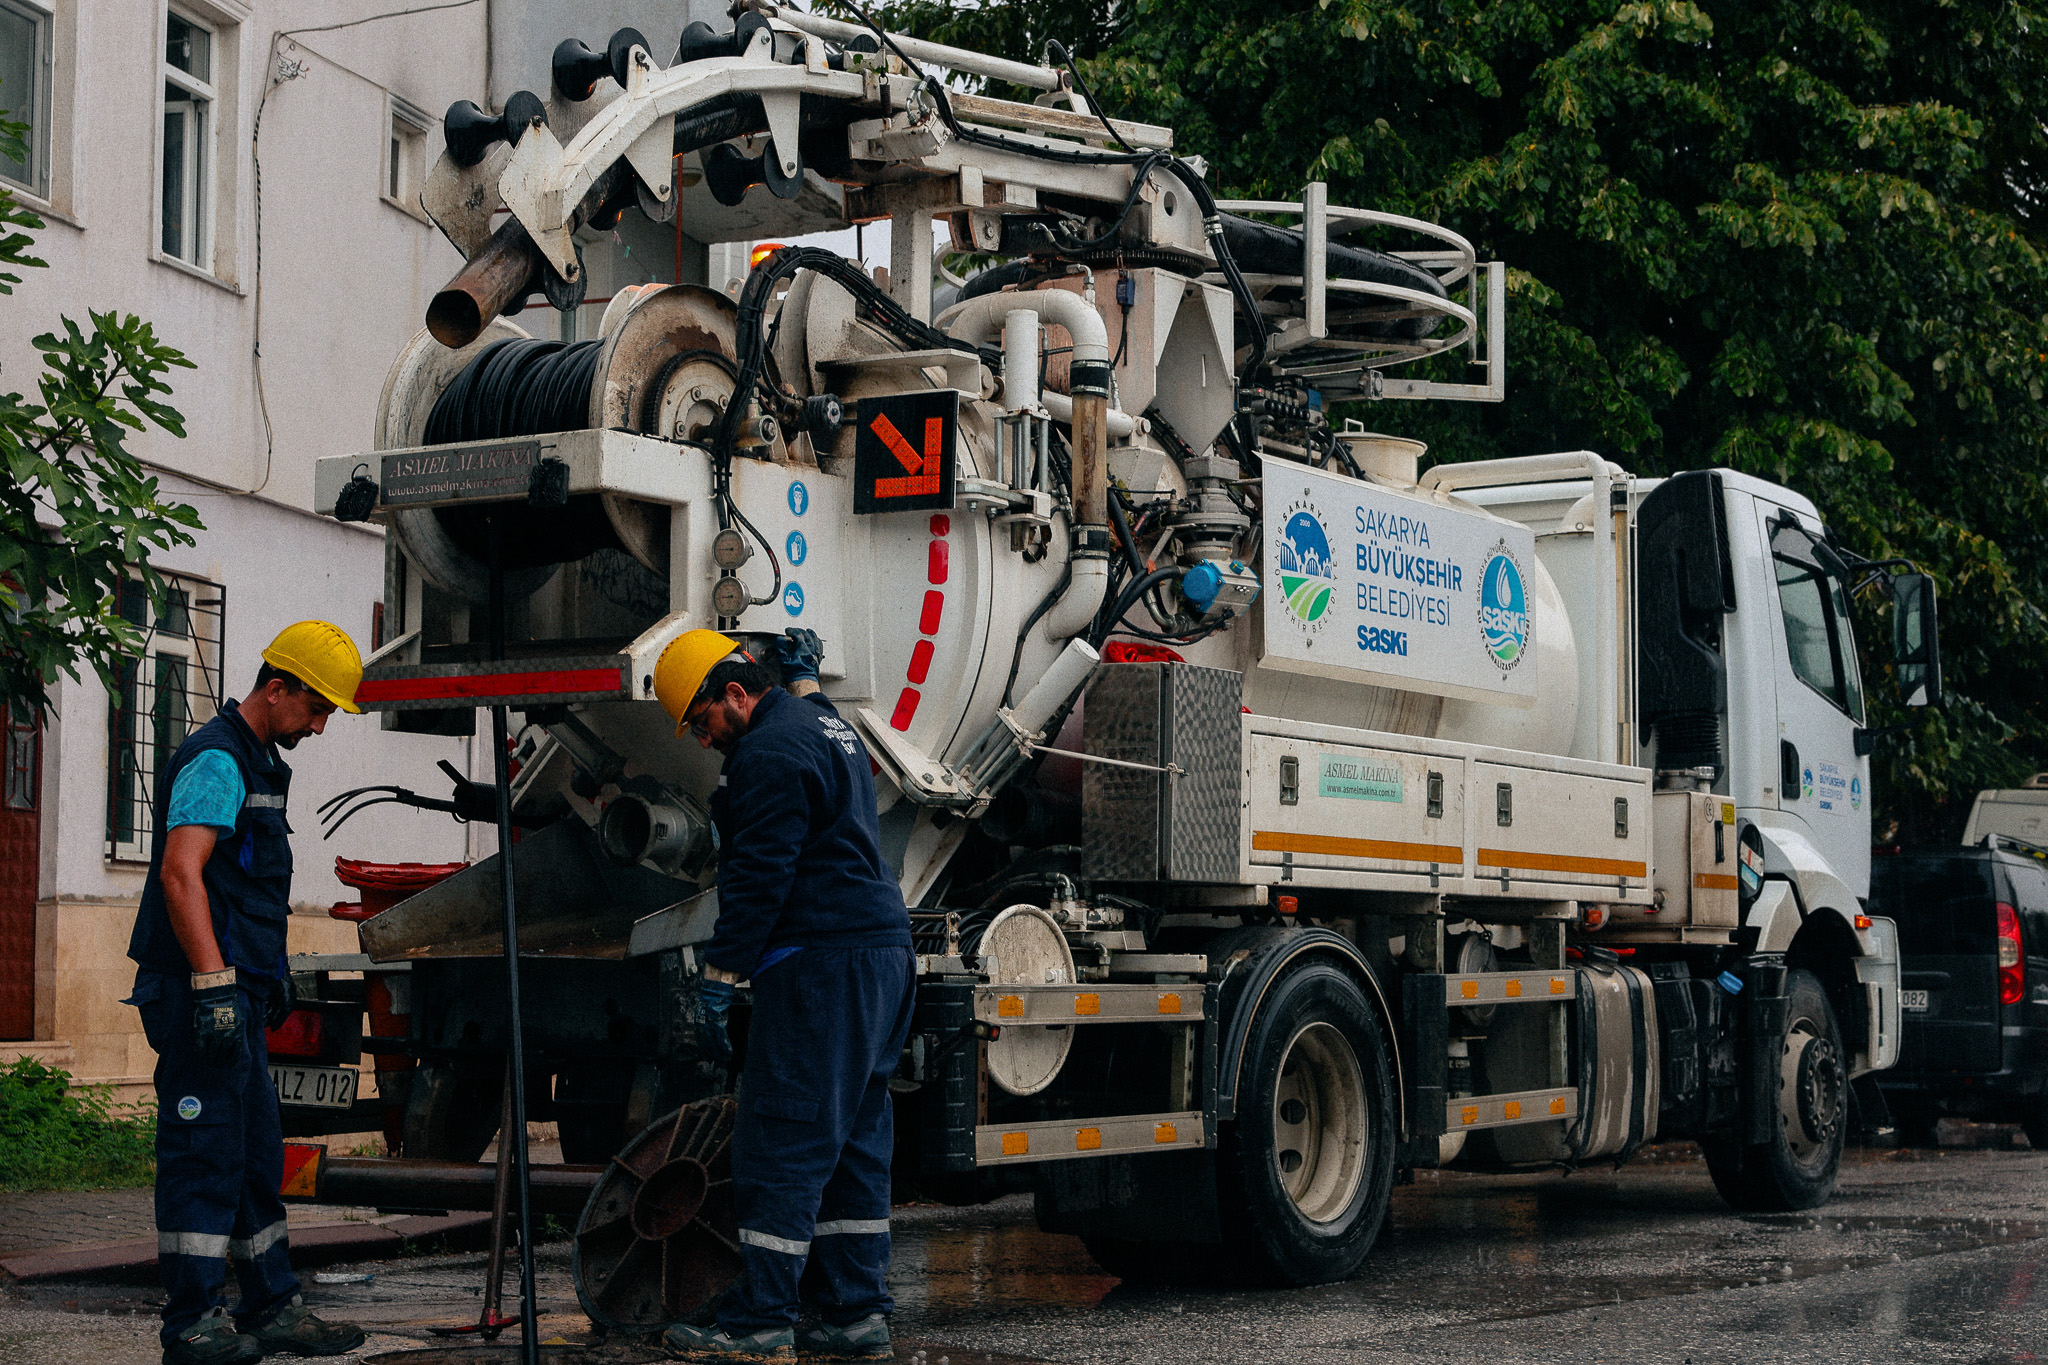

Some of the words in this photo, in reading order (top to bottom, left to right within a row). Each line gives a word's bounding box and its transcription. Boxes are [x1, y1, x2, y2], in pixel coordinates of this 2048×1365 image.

[389, 455, 450, 478] ASMEL
[387, 474, 531, 497] www.asmelmakina.com.tr
[1282, 500, 1328, 531] SAKARYA
[1299, 518, 1311, 528] 2000
[1355, 505, 1431, 549] SAKARYA
[1356, 539, 1463, 592] BÜYÜKŞEHİR
[1357, 582, 1450, 627] BELEDİYESİ
[1324, 762, 1359, 780] ASMEL
[1360, 764, 1399, 784] MAKİNA
[1326, 784, 1396, 798] www.asmelmakina.com.tr
[1902, 992, 1926, 1006] 082
[316, 1072, 351, 1104] 012
